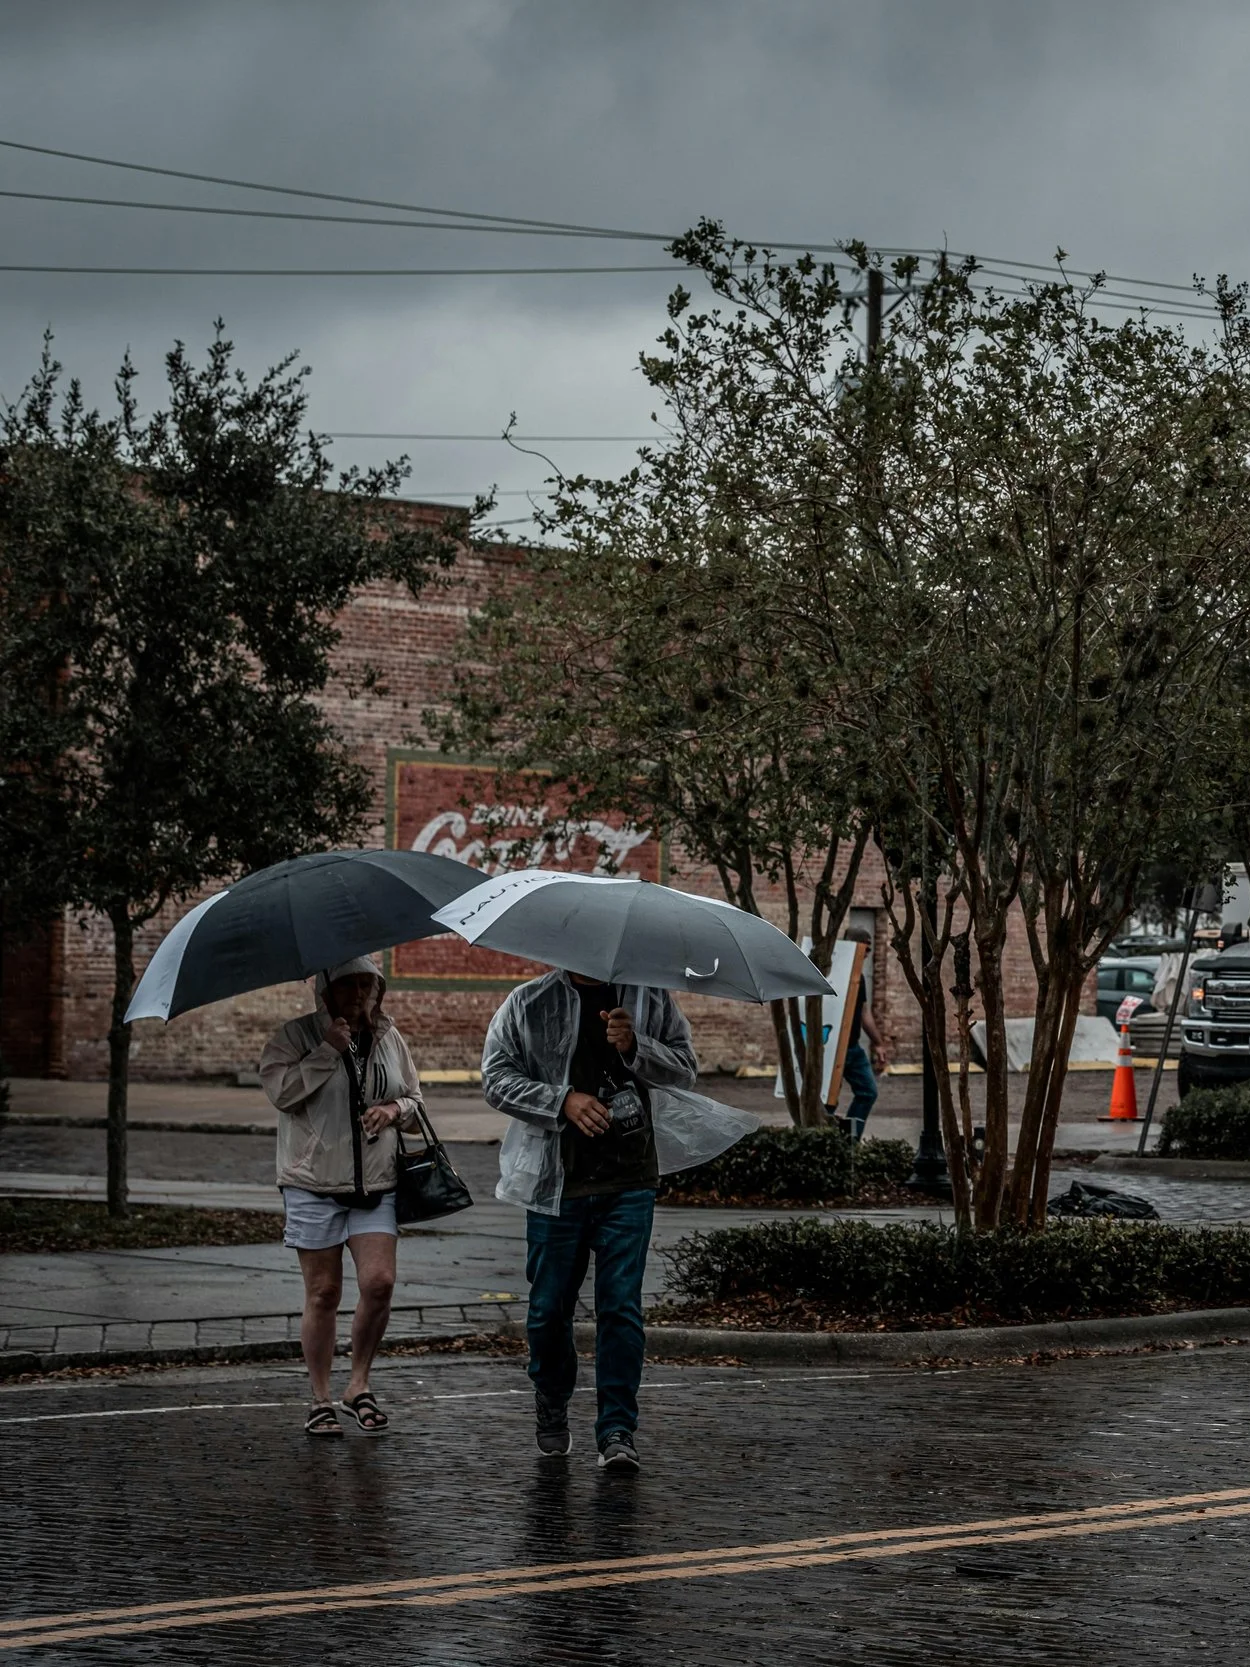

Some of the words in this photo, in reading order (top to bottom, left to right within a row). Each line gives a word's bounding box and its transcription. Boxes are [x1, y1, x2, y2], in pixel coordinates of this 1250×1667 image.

[460, 875, 568, 925] NAUTICA
[613, 1095, 630, 1107] VIP
[621, 1116, 639, 1129] VIP
